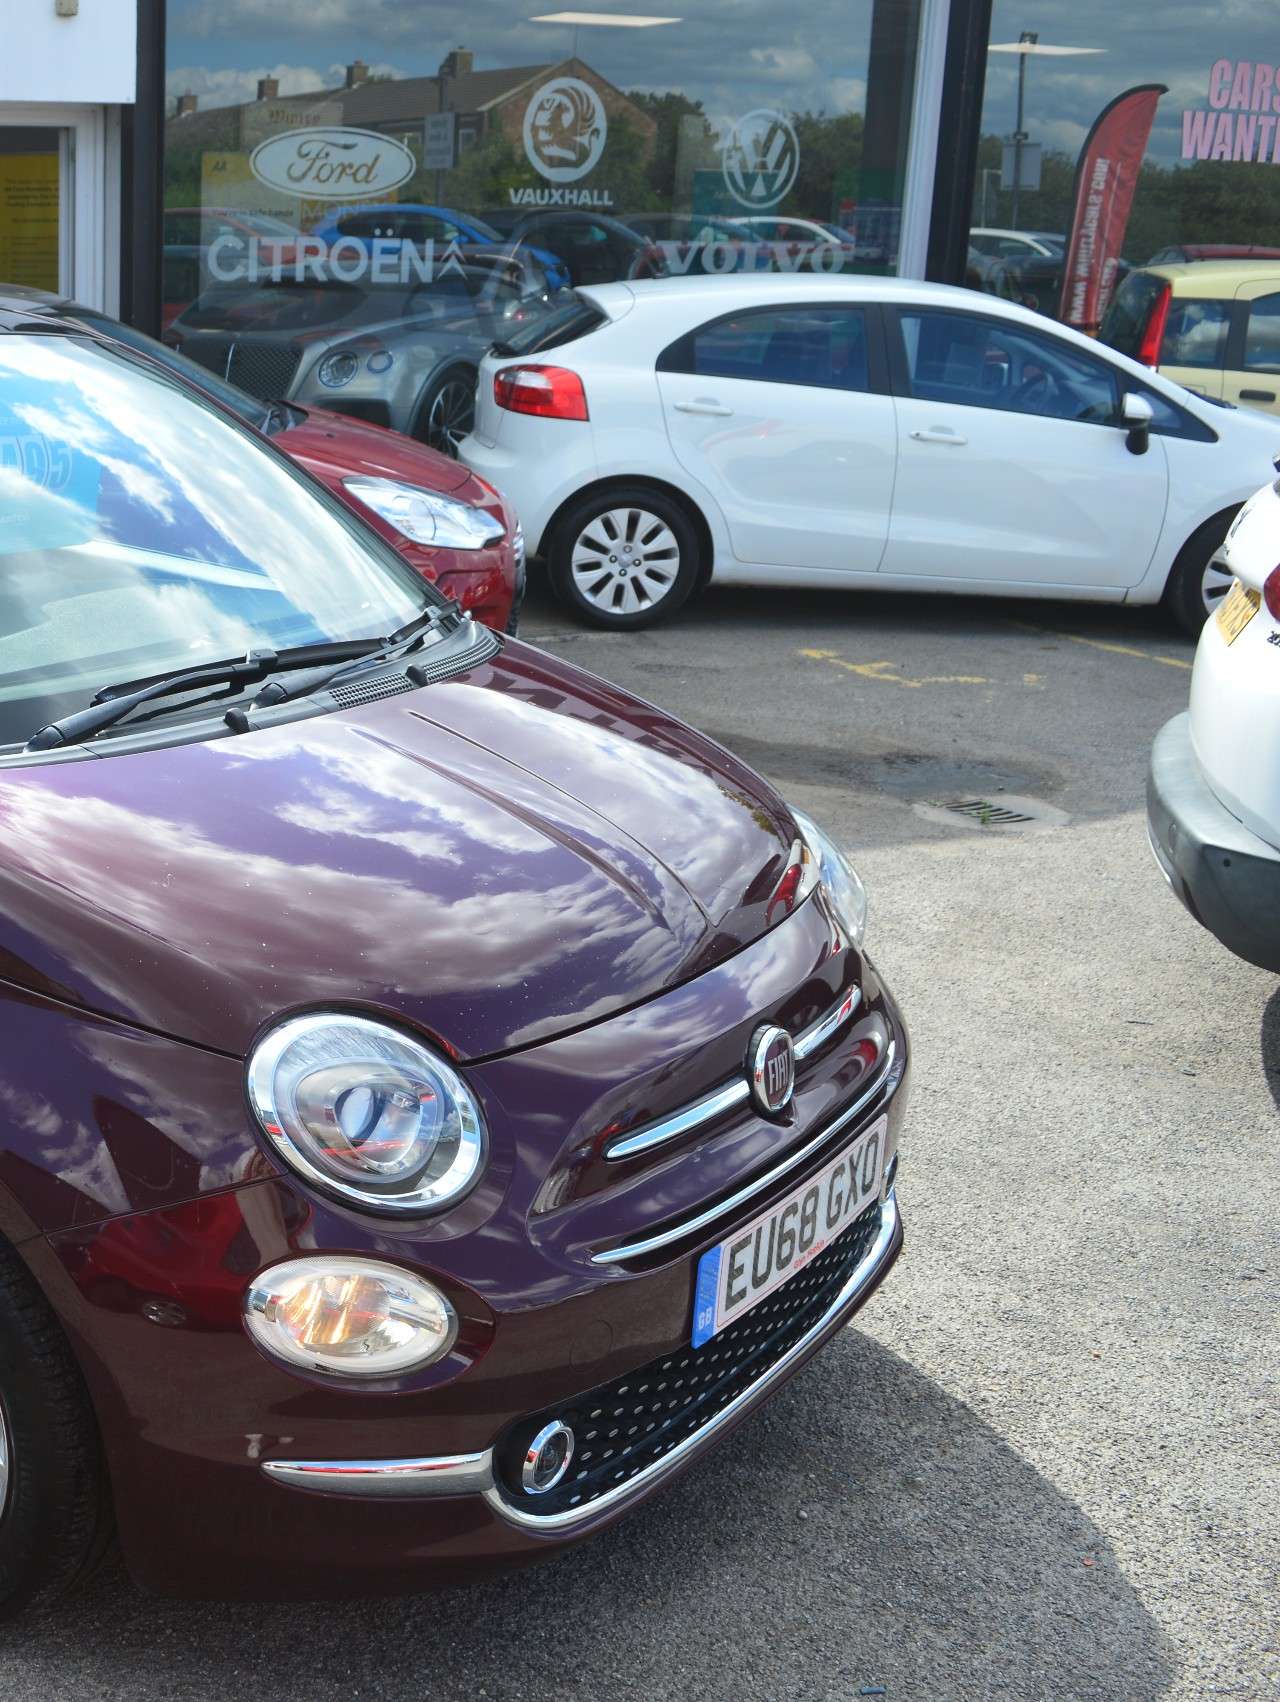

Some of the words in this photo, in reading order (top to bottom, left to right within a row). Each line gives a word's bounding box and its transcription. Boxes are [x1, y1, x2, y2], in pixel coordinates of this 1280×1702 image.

[287, 139, 381, 184] Ford
[509, 188, 613, 206] VAUXHALL
[207, 228, 434, 283] CITROËN
[656, 240, 845, 274] VOLVO
[768, 1050, 790, 1095] FIAT
[725, 1186, 819, 1312] EU68
[826, 1131, 879, 1230] GXO
[698, 1306, 712, 1331] GB
